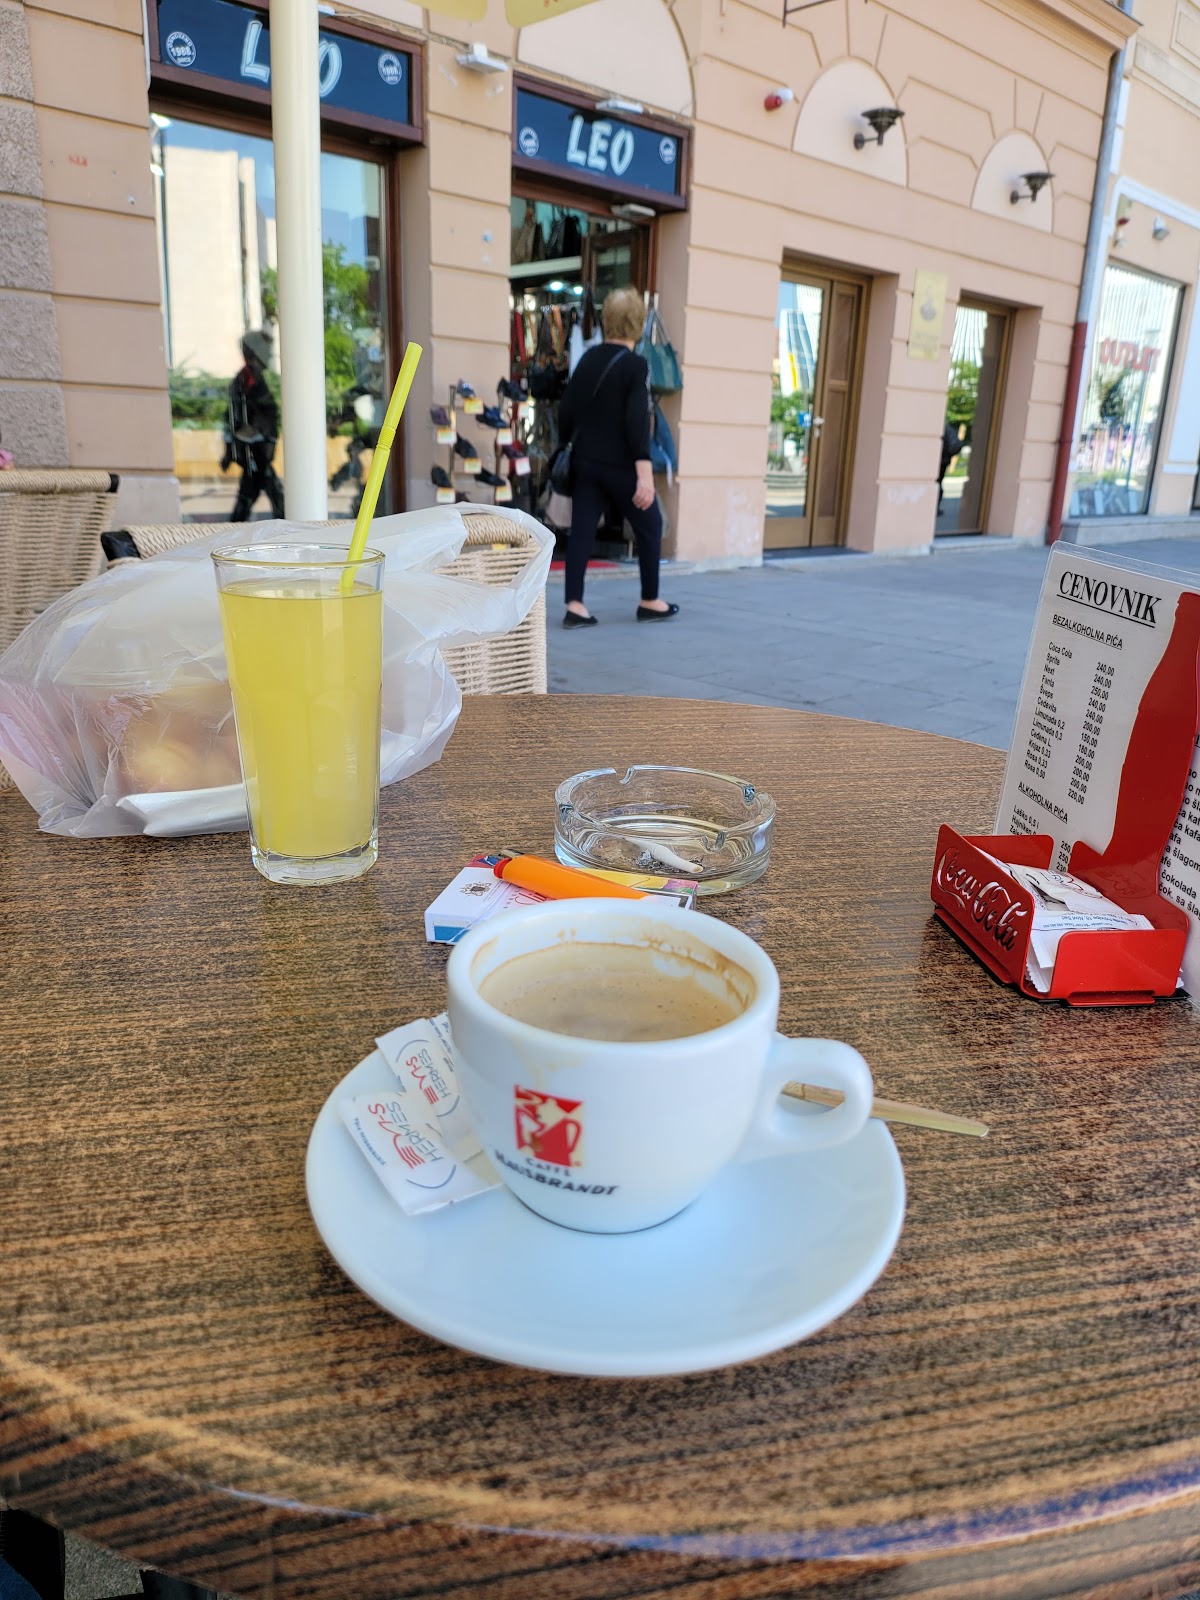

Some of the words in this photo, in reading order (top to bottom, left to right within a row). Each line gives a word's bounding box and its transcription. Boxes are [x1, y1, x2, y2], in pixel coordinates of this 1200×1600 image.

[241, 19, 342, 97] LO
[567, 114, 635, 176] LEO
[1059, 571, 1162, 624] CENOVNIK
[1052, 614, 1104, 642] BEZALKOHOLNA
[1105, 634, 1123, 649] PIĆA
[1046, 652, 1060, 666] Sprite
[1093, 674, 1112, 689] 240,00
[1048, 642, 1060, 654] Coca
[1061, 647, 1072, 659] Cola
[1096, 662, 1115, 677] 240,00
[1037, 696, 1057, 714] Cedevita
[1041, 674, 1055, 688] Fanta
[1088, 698, 1106, 713] 240,00
[1090, 686, 1109, 701] 250,00
[1032, 717, 1055, 737] Limunada
[1034, 706, 1057, 726] Limunada
[1085, 708, 1104, 725] 240,00
[1026, 749, 1038, 763] Rosa
[1018, 781, 1053, 812] ALKOHOLNA
[1024, 760, 1036, 773] Rosa
[1067, 788, 1085, 805] 220,00
[1176, 895, 1186, 906] sa
[417, 1048, 451, 1098] HERMES
[386, 1101, 444, 1162] HERMES
[494, 1149, 619, 1196] HAUSBRANDT
